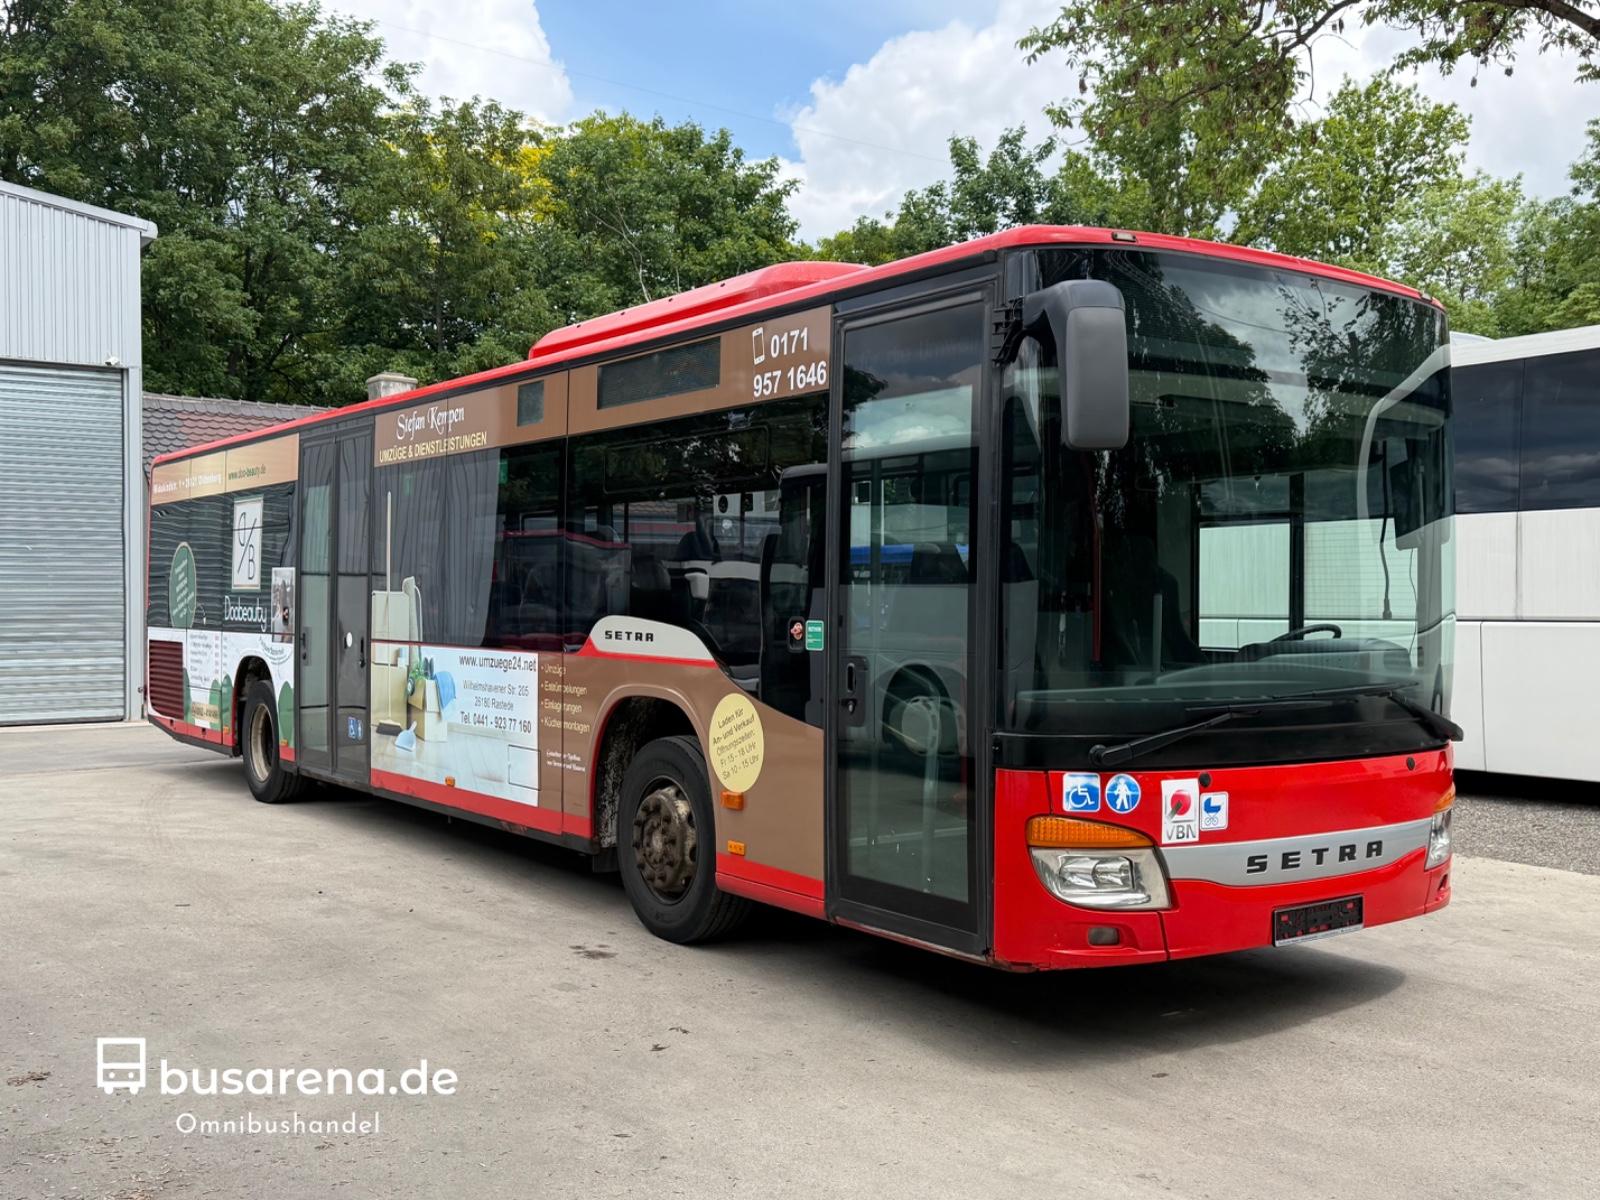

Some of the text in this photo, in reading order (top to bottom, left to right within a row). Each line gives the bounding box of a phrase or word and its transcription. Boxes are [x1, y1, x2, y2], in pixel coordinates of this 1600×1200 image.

[770, 326, 808, 358] 0171
[753, 360, 827, 397] 957 1646
[396, 406, 465, 440] Stefan Kempen
[380, 431, 487, 463] UMZÜGE & DIENSTLEISTUNGEN
[604, 630, 654, 642] SETRA
[460, 711, 471, 725] Tel.
[473, 713, 489, 728] 0441
[494, 716, 507, 730] 923
[508, 718, 517, 732] 77
[519, 720, 532, 733] 160
[717, 713, 735, 729] Laden
[722, 729, 733, 740] und
[733, 714, 755, 731] Verkauf
[1166, 823, 1197, 841] VBN
[1246, 840, 1383, 874] SETRA
